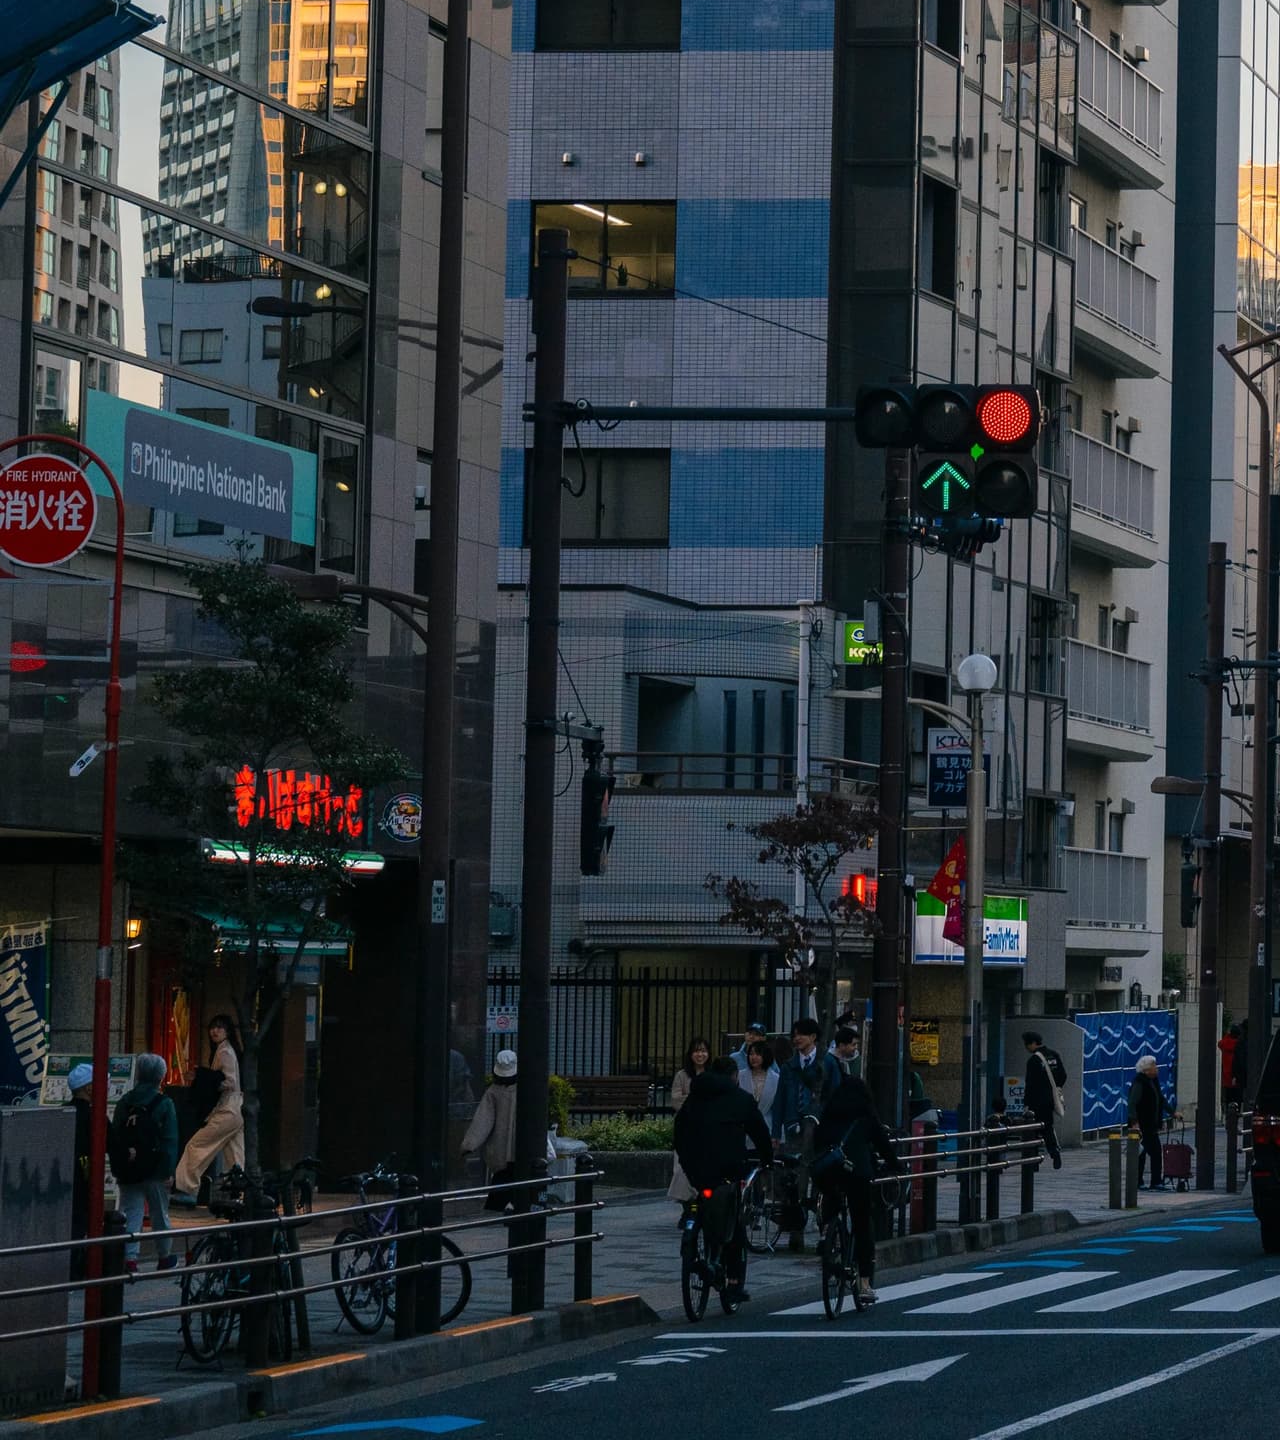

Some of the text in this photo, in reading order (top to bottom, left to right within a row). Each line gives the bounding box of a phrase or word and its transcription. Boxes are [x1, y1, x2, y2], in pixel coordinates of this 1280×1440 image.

[6, 470, 77, 483] FIRE HYDRANT
[143, 444, 287, 513] Philippine National Bank
[0, 489, 87, 531] 消火栓
